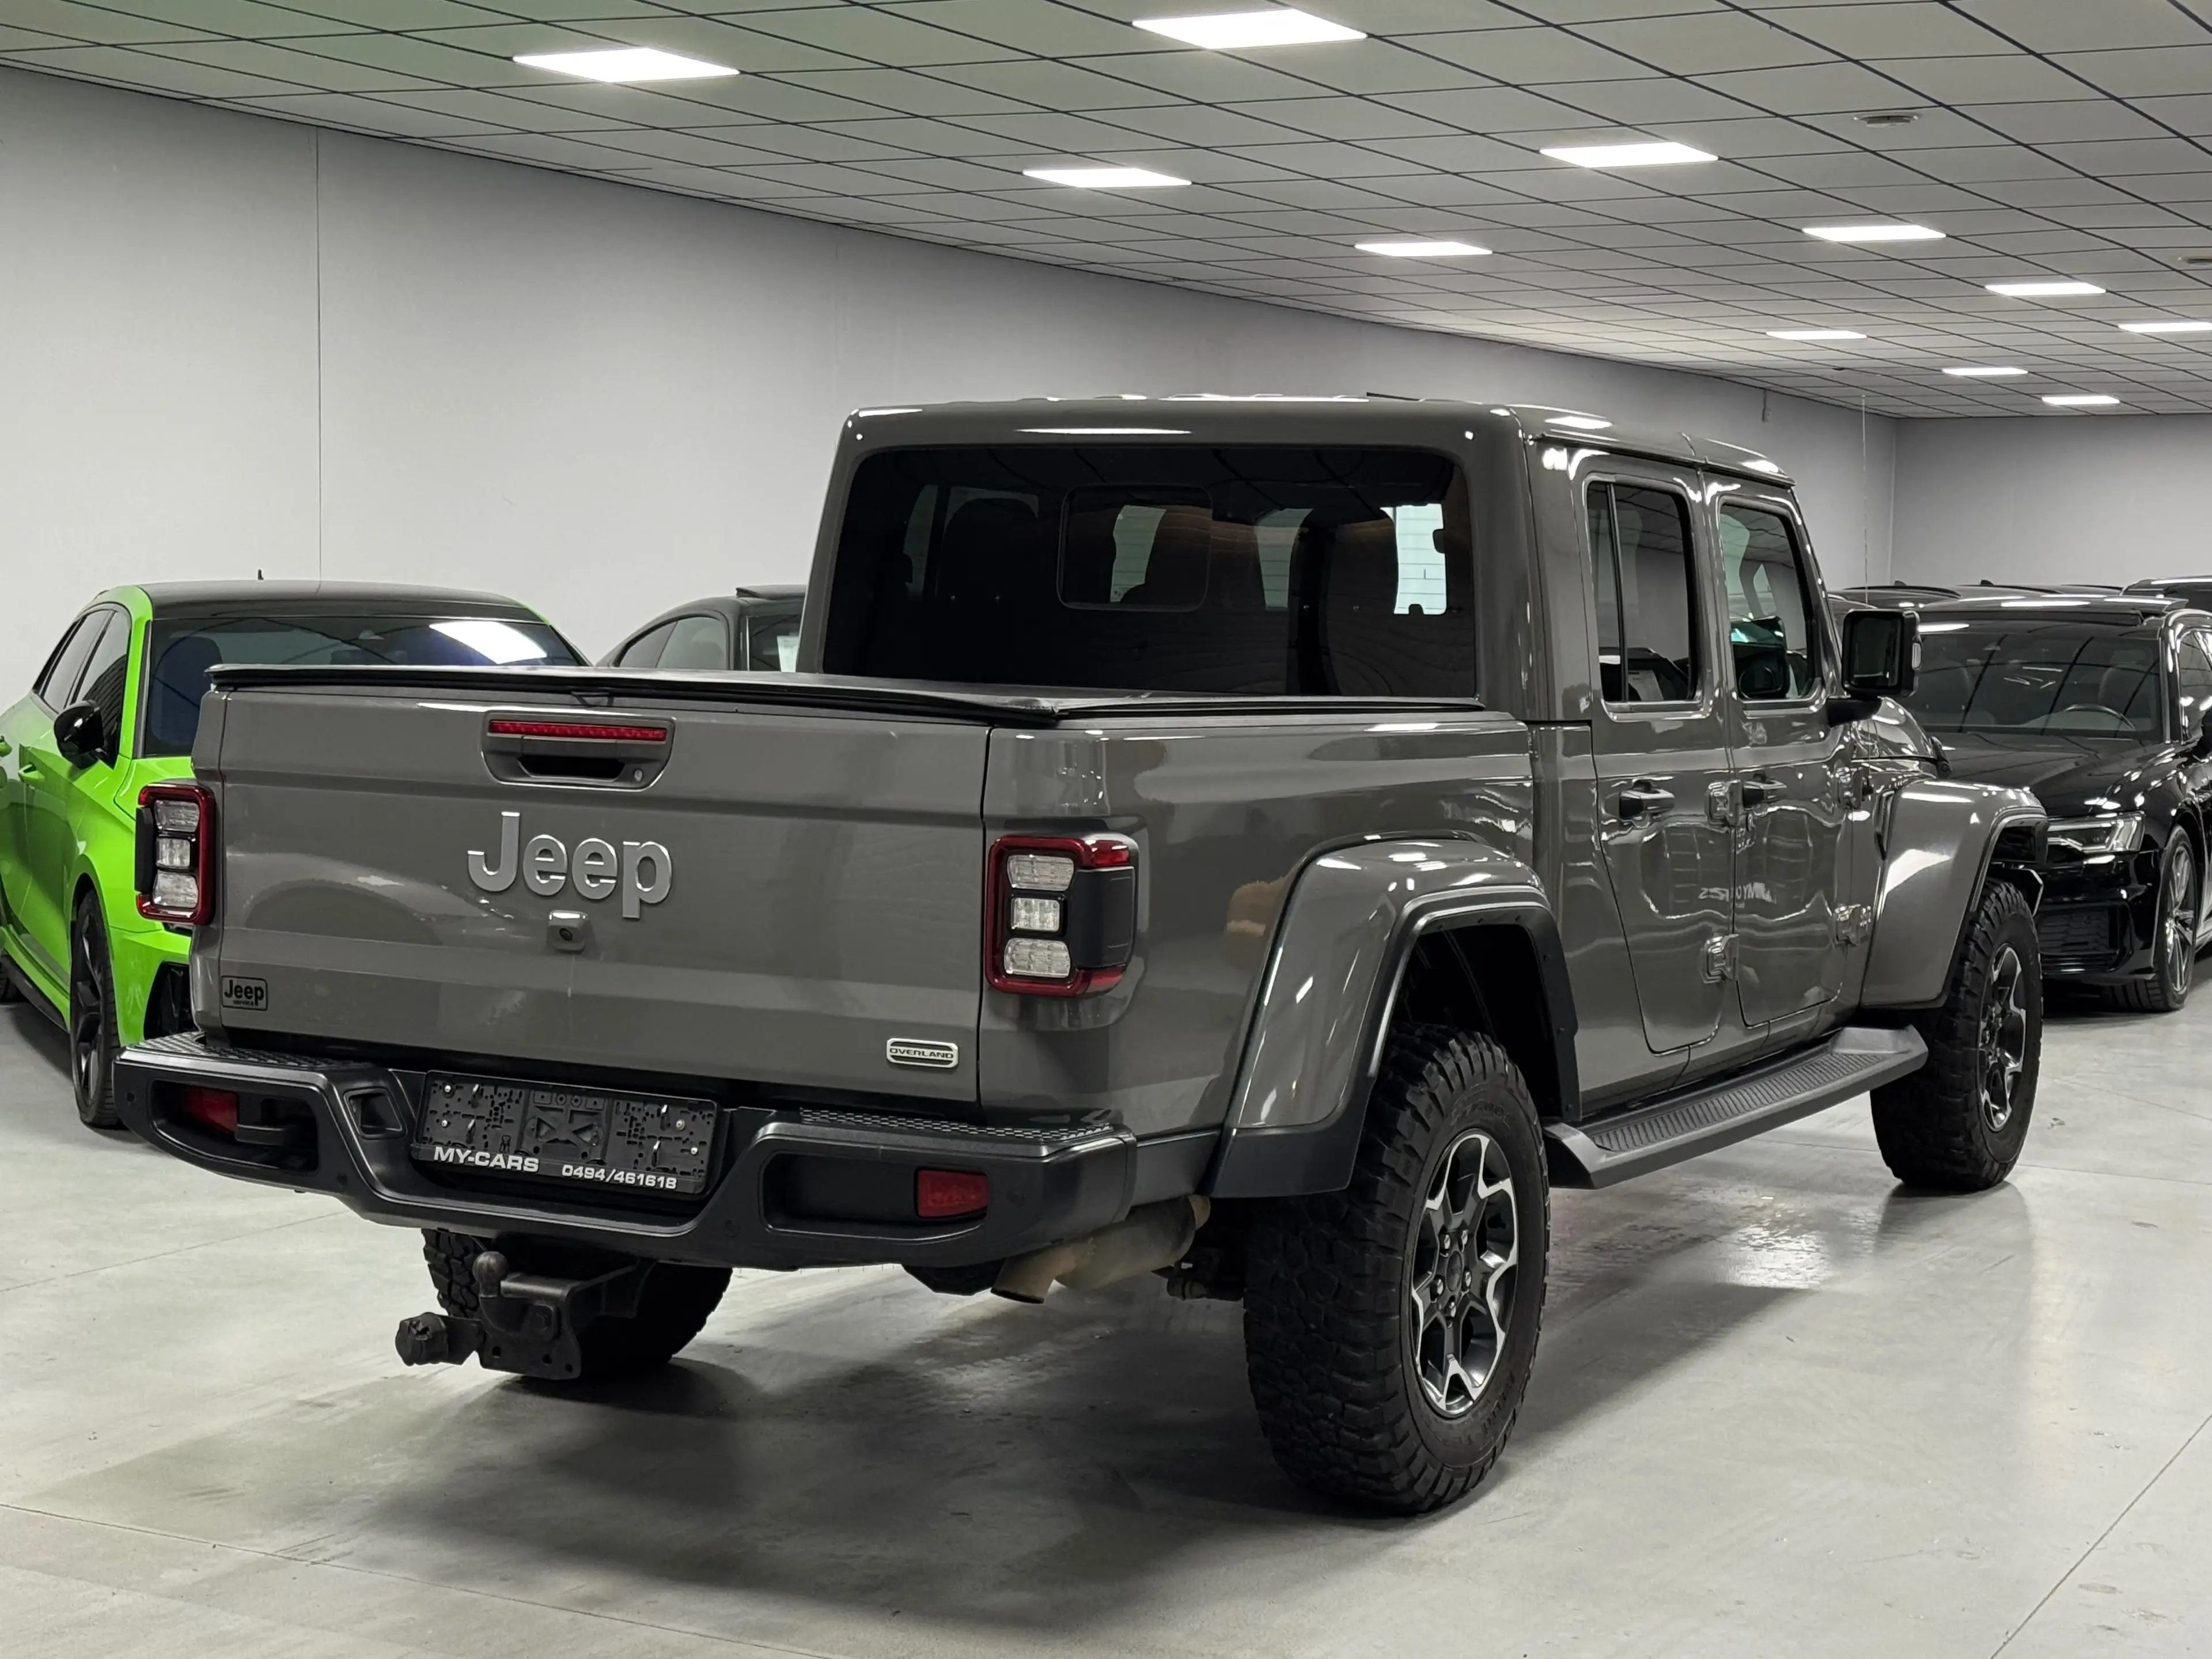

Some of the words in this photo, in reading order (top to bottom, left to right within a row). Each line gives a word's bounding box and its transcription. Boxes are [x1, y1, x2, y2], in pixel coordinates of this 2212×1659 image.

[467, 811, 673, 919] Jeep
[224, 979, 264, 1006] Jeep
[889, 1048, 954, 1059] OVERLAND
[434, 1146, 539, 1173] MY-CARS
[562, 1164, 677, 1190] 0494/461618
